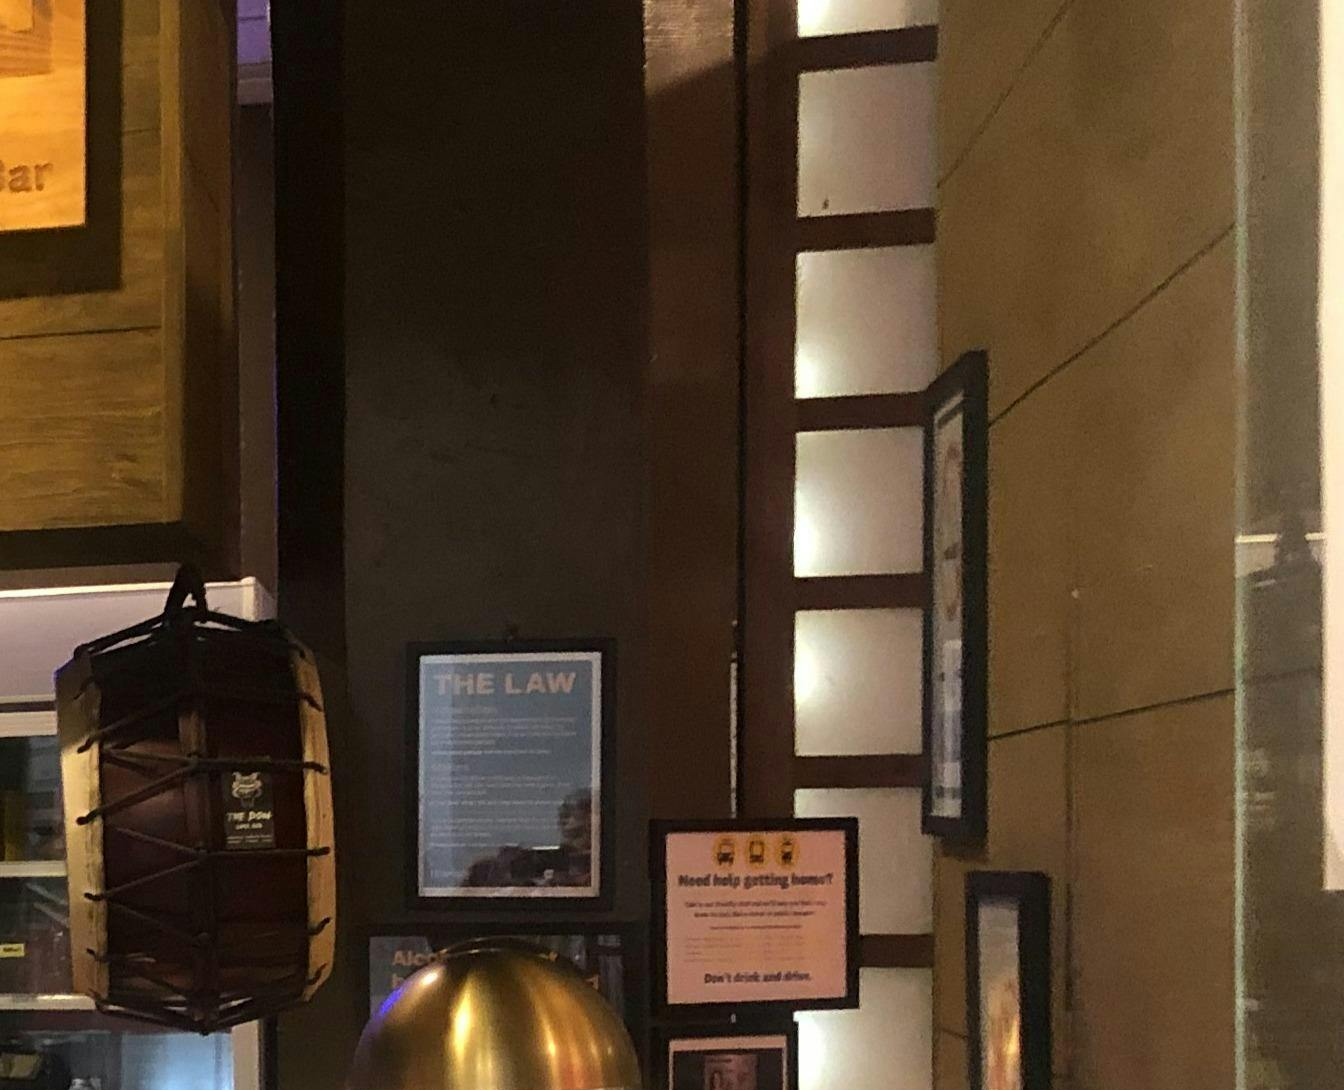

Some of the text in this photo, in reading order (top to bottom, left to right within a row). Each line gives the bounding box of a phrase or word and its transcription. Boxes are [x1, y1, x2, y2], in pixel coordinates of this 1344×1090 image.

[433, 670, 577, 697] THE LAW
[678, 873, 710, 887] Need
[713, 872, 740, 889] help
[744, 873, 789, 890] getting
[763, 970, 782, 982] and
